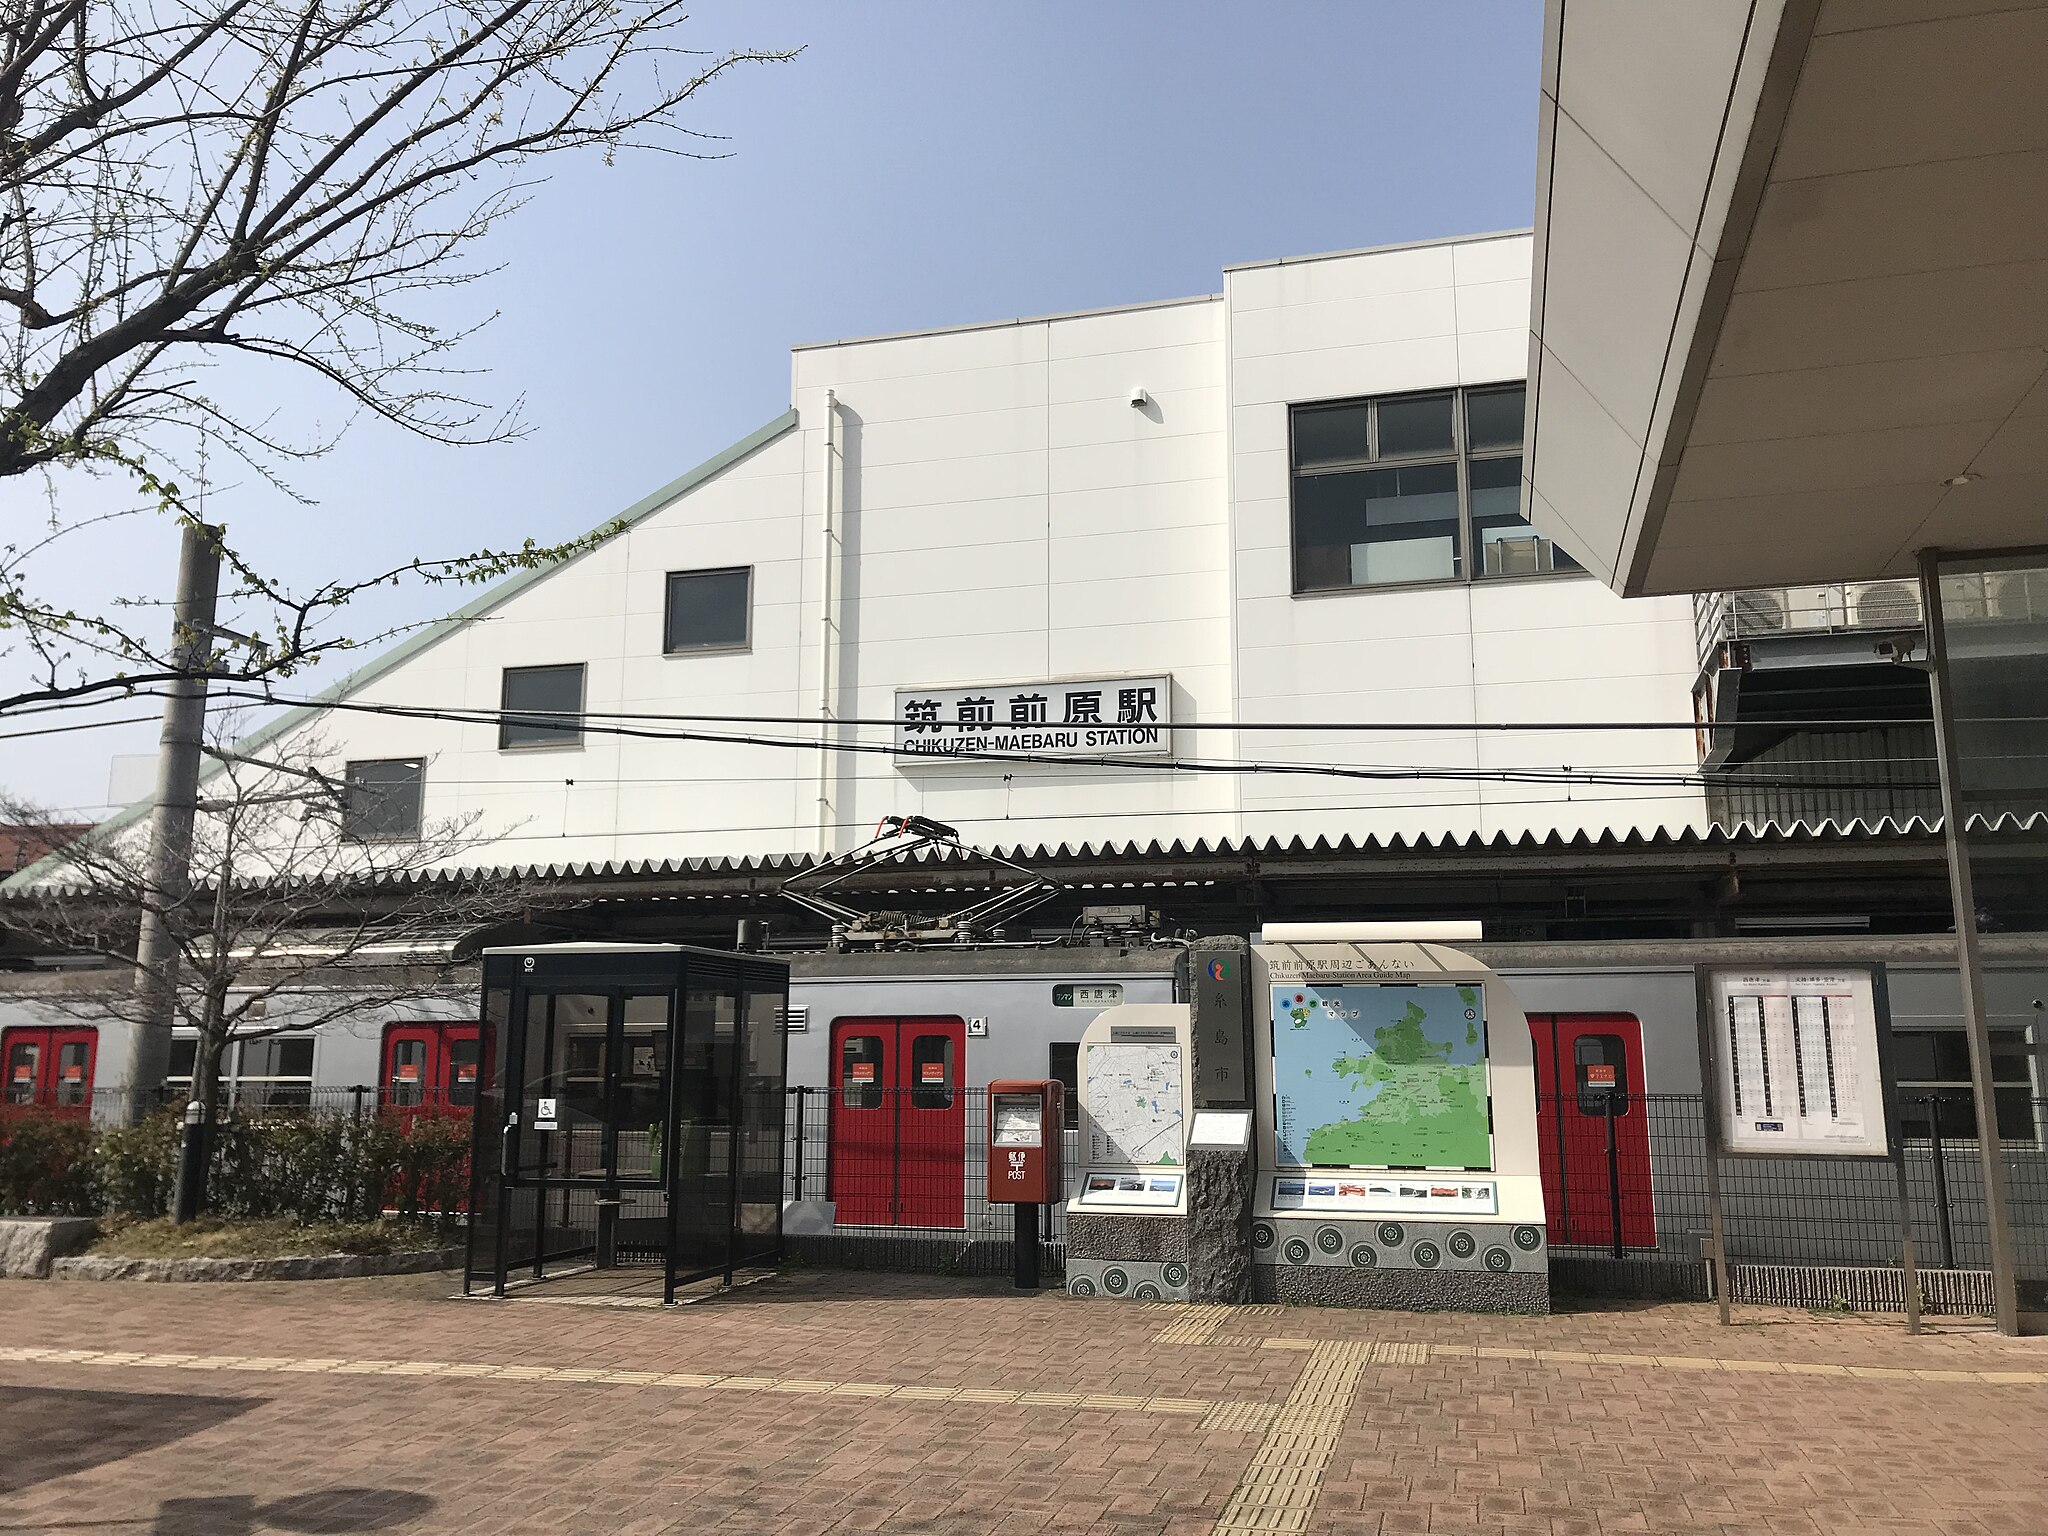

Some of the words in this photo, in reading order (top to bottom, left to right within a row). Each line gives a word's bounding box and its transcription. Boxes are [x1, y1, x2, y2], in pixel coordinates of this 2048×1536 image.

[903, 687, 1158, 733] 筑前前原駅
[903, 731, 1078, 754] CHIKUZEN-MAEBARU
[1085, 727, 1158, 746] STATION
[1356, 971, 1372, 979] Area
[1373, 971, 1394, 979] Guide
[1395, 971, 1411, 980] Map
[1080, 989, 1118, 999] 西唐津
[973, 1020, 981, 1030] 4
[1214, 993, 1229, 1083] 糸島市
[1008, 1151, 1026, 1162] 郵便
[1008, 1171, 1025, 1180] POST
